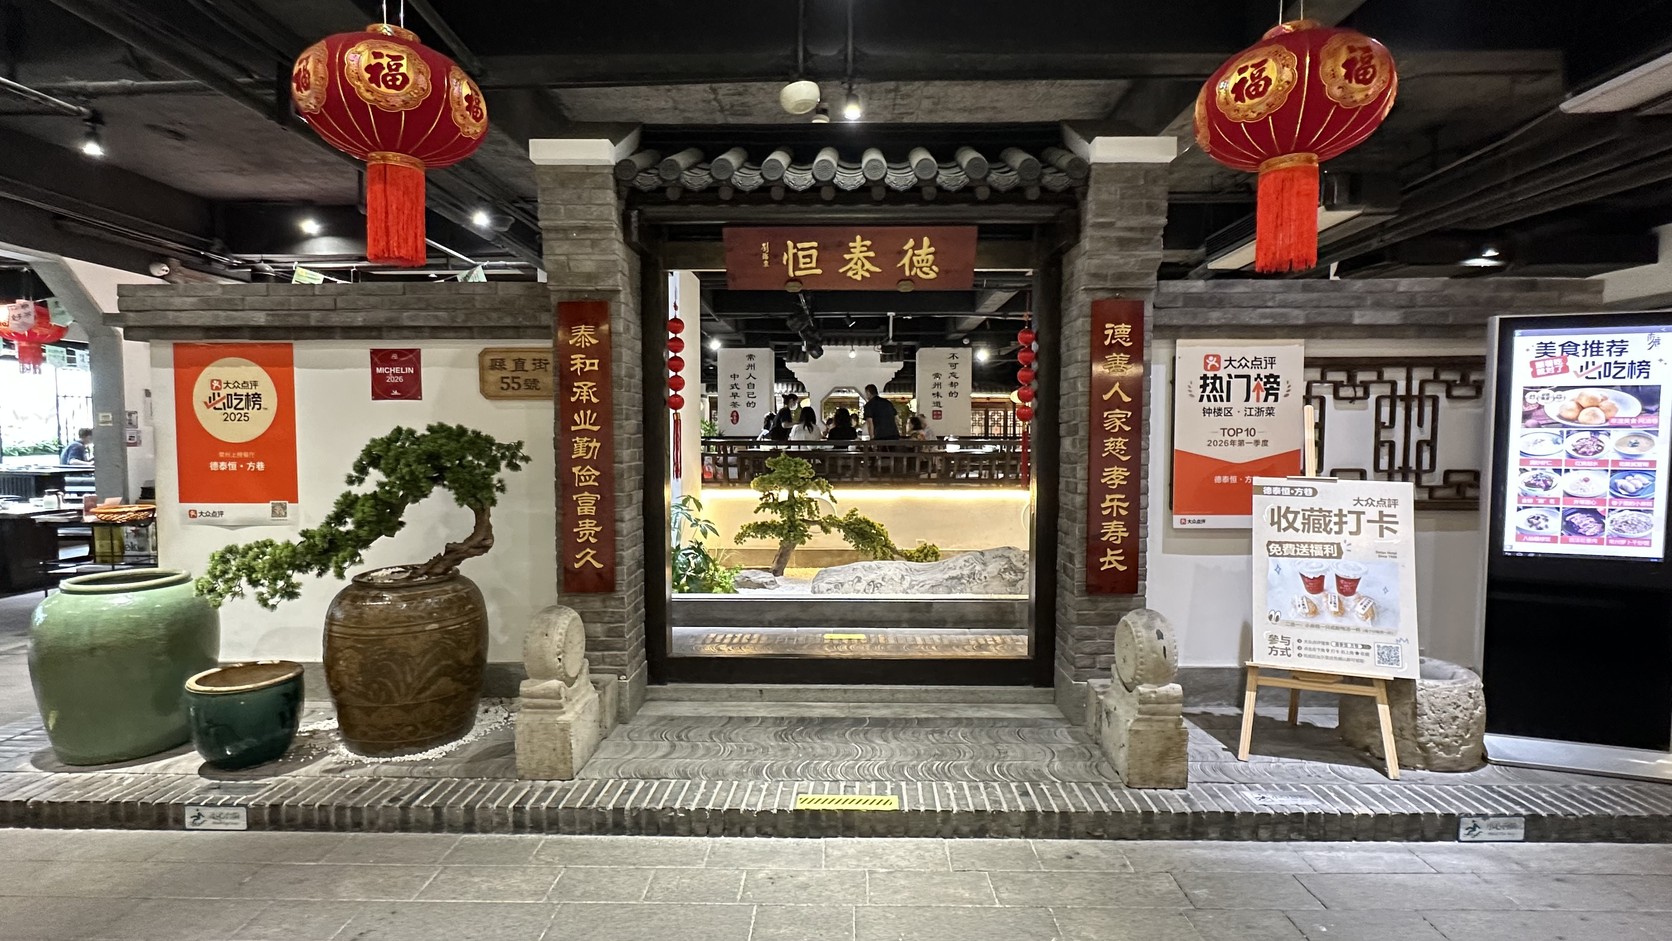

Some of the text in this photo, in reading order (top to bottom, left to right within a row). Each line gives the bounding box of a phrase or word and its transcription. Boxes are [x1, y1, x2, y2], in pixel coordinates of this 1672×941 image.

[365, 51, 410, 91] 福
[1341, 45, 1377, 86] 福
[1231, 58, 1273, 104] 福
[464, 81, 485, 123] 福
[1535, 339, 1629, 358] 美食推荐
[376, 367, 415, 375] MICHELIN
[1223, 356, 1276, 370] 大众点评
[1574, 360, 1651, 380] 必吃榜
[223, 380, 259, 390] 大众点评
[386, 375, 404, 383] 2026
[745, 353, 757, 409] 常州人自己的
[948, 353, 959, 398] 不可忘却的
[729, 373, 741, 409] 中式早茶
[931, 372, 943, 408] 常州味道
[1198, 373, 1281, 403] 热门榜
[204, 392, 263, 411] 必吃榜
[223, 412, 250, 422] 2025
[568, 324, 605, 569] 泰和承业勤俭富贵久
[1207, 439, 1269, 447] 2026年第一季度
[198, 510, 224, 518] 大众点评
[1269, 505, 1399, 538] 收藏打卡
[1268, 543, 1338, 557] 免費送福利
[1268, 646, 1291, 658] 方式
